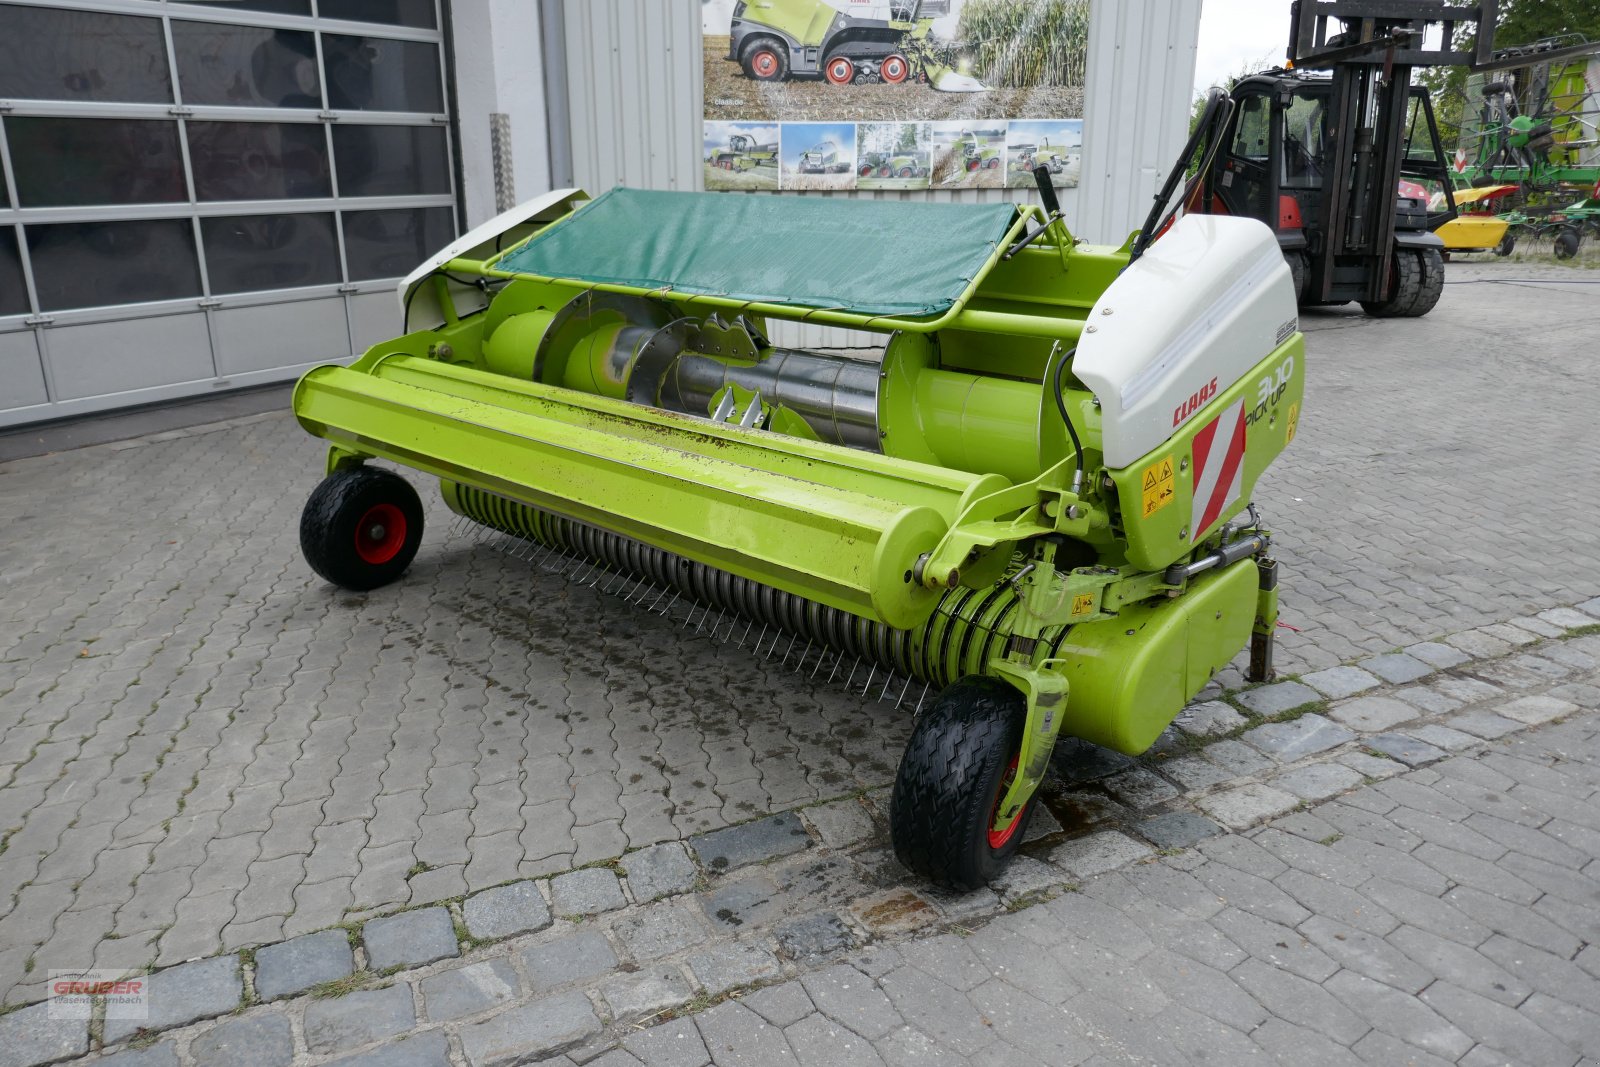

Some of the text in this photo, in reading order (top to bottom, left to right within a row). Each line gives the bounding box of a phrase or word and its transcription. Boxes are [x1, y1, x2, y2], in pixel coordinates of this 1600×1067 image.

[1172, 376, 1218, 427] CLAAS
[1245, 381, 1287, 427] PICK UP
